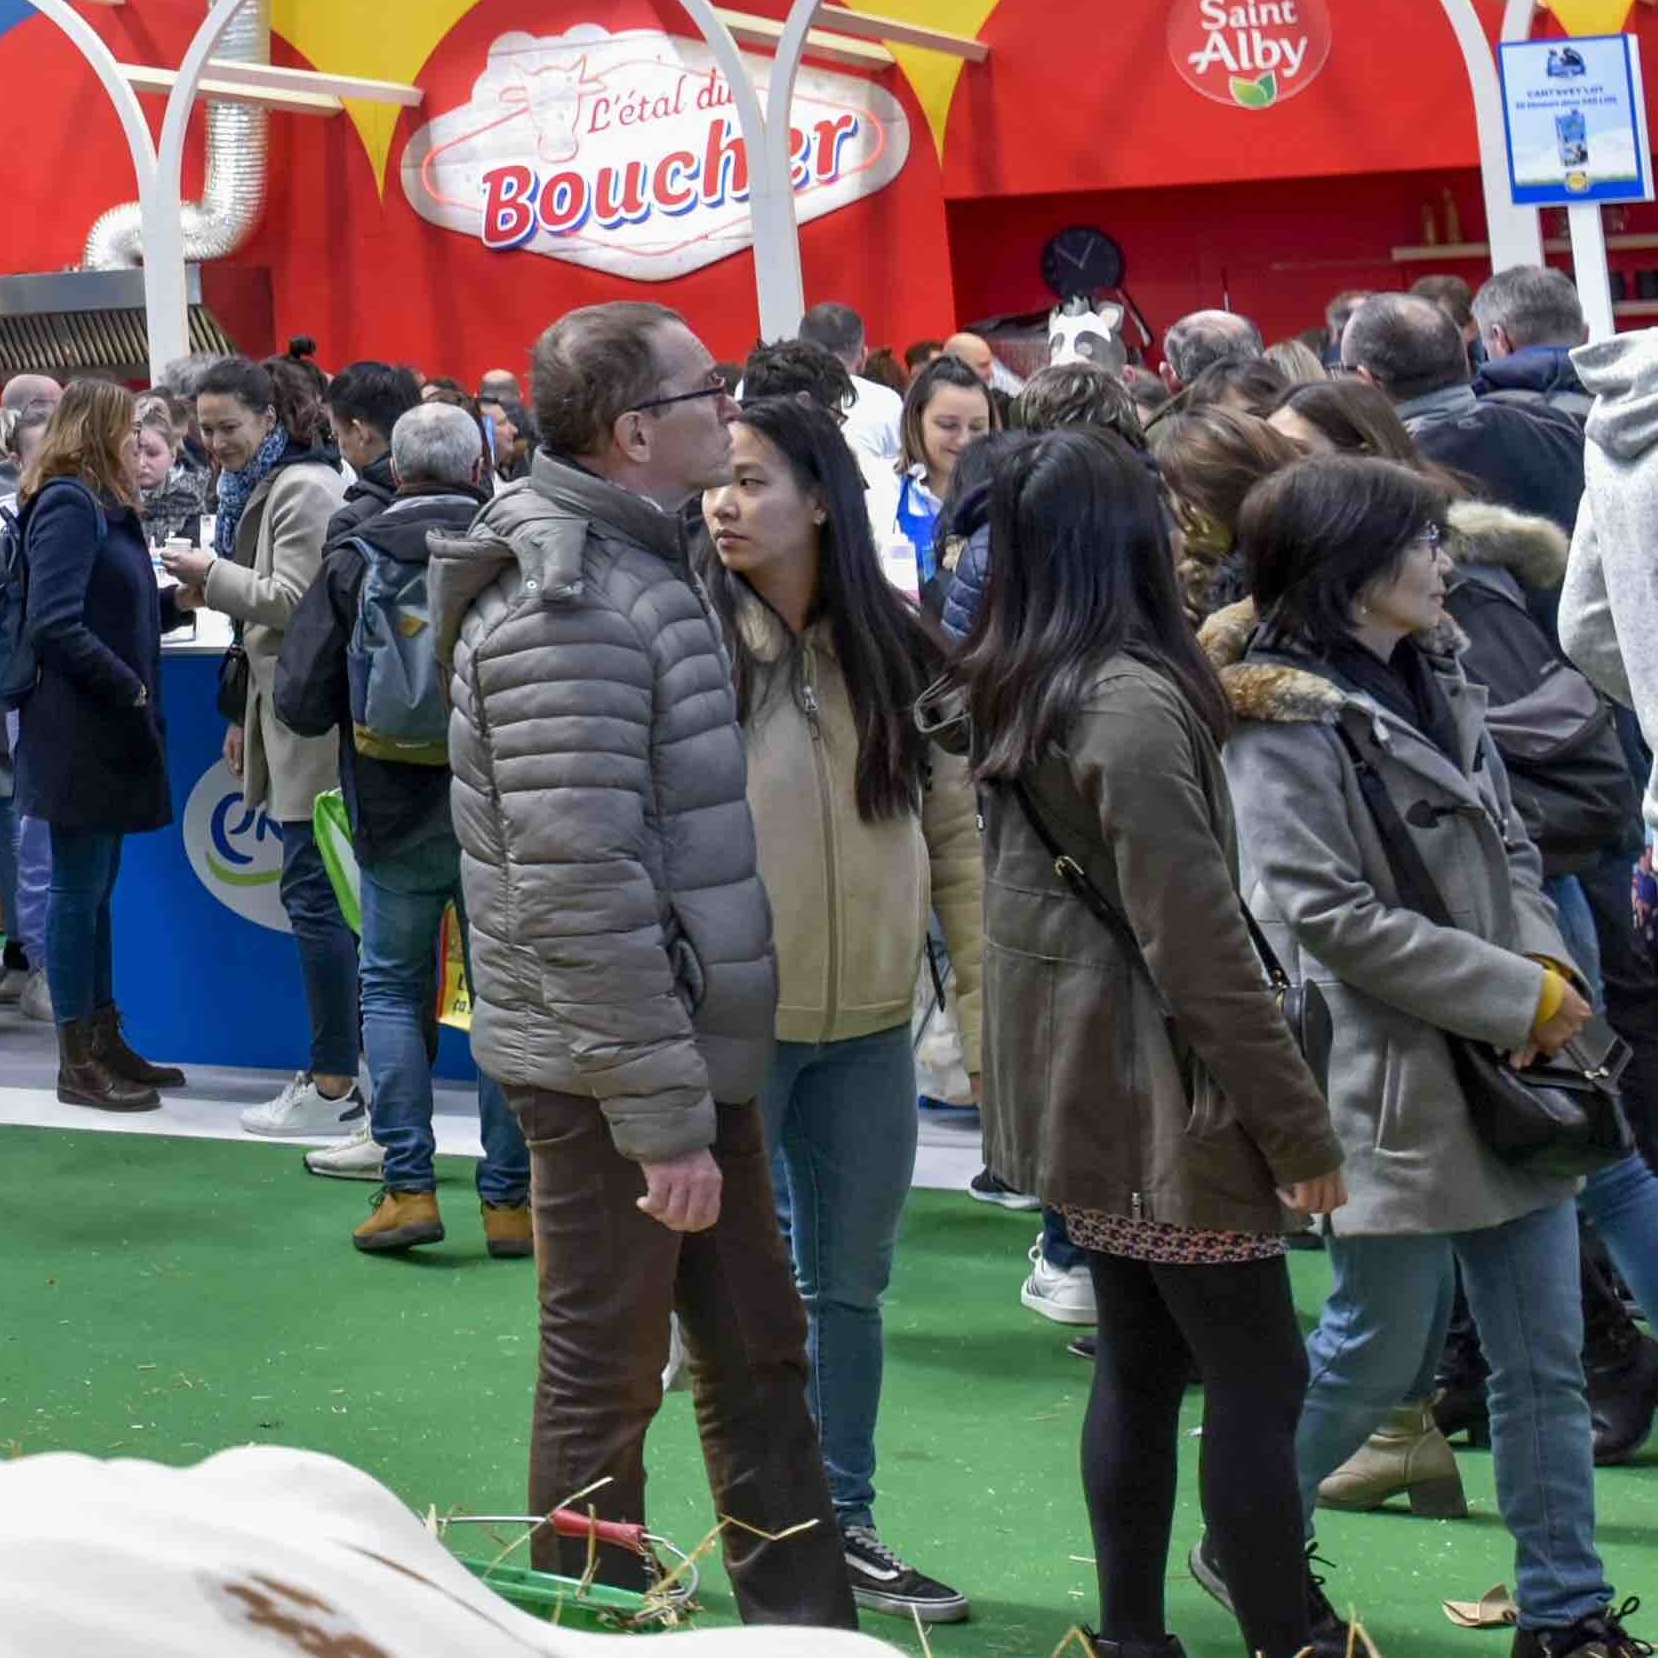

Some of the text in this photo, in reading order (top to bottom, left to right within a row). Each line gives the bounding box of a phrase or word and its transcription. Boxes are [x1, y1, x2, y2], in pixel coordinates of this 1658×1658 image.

[1188, 29, 1308, 78] Alby
[587, 66, 736, 135] L'étal du
